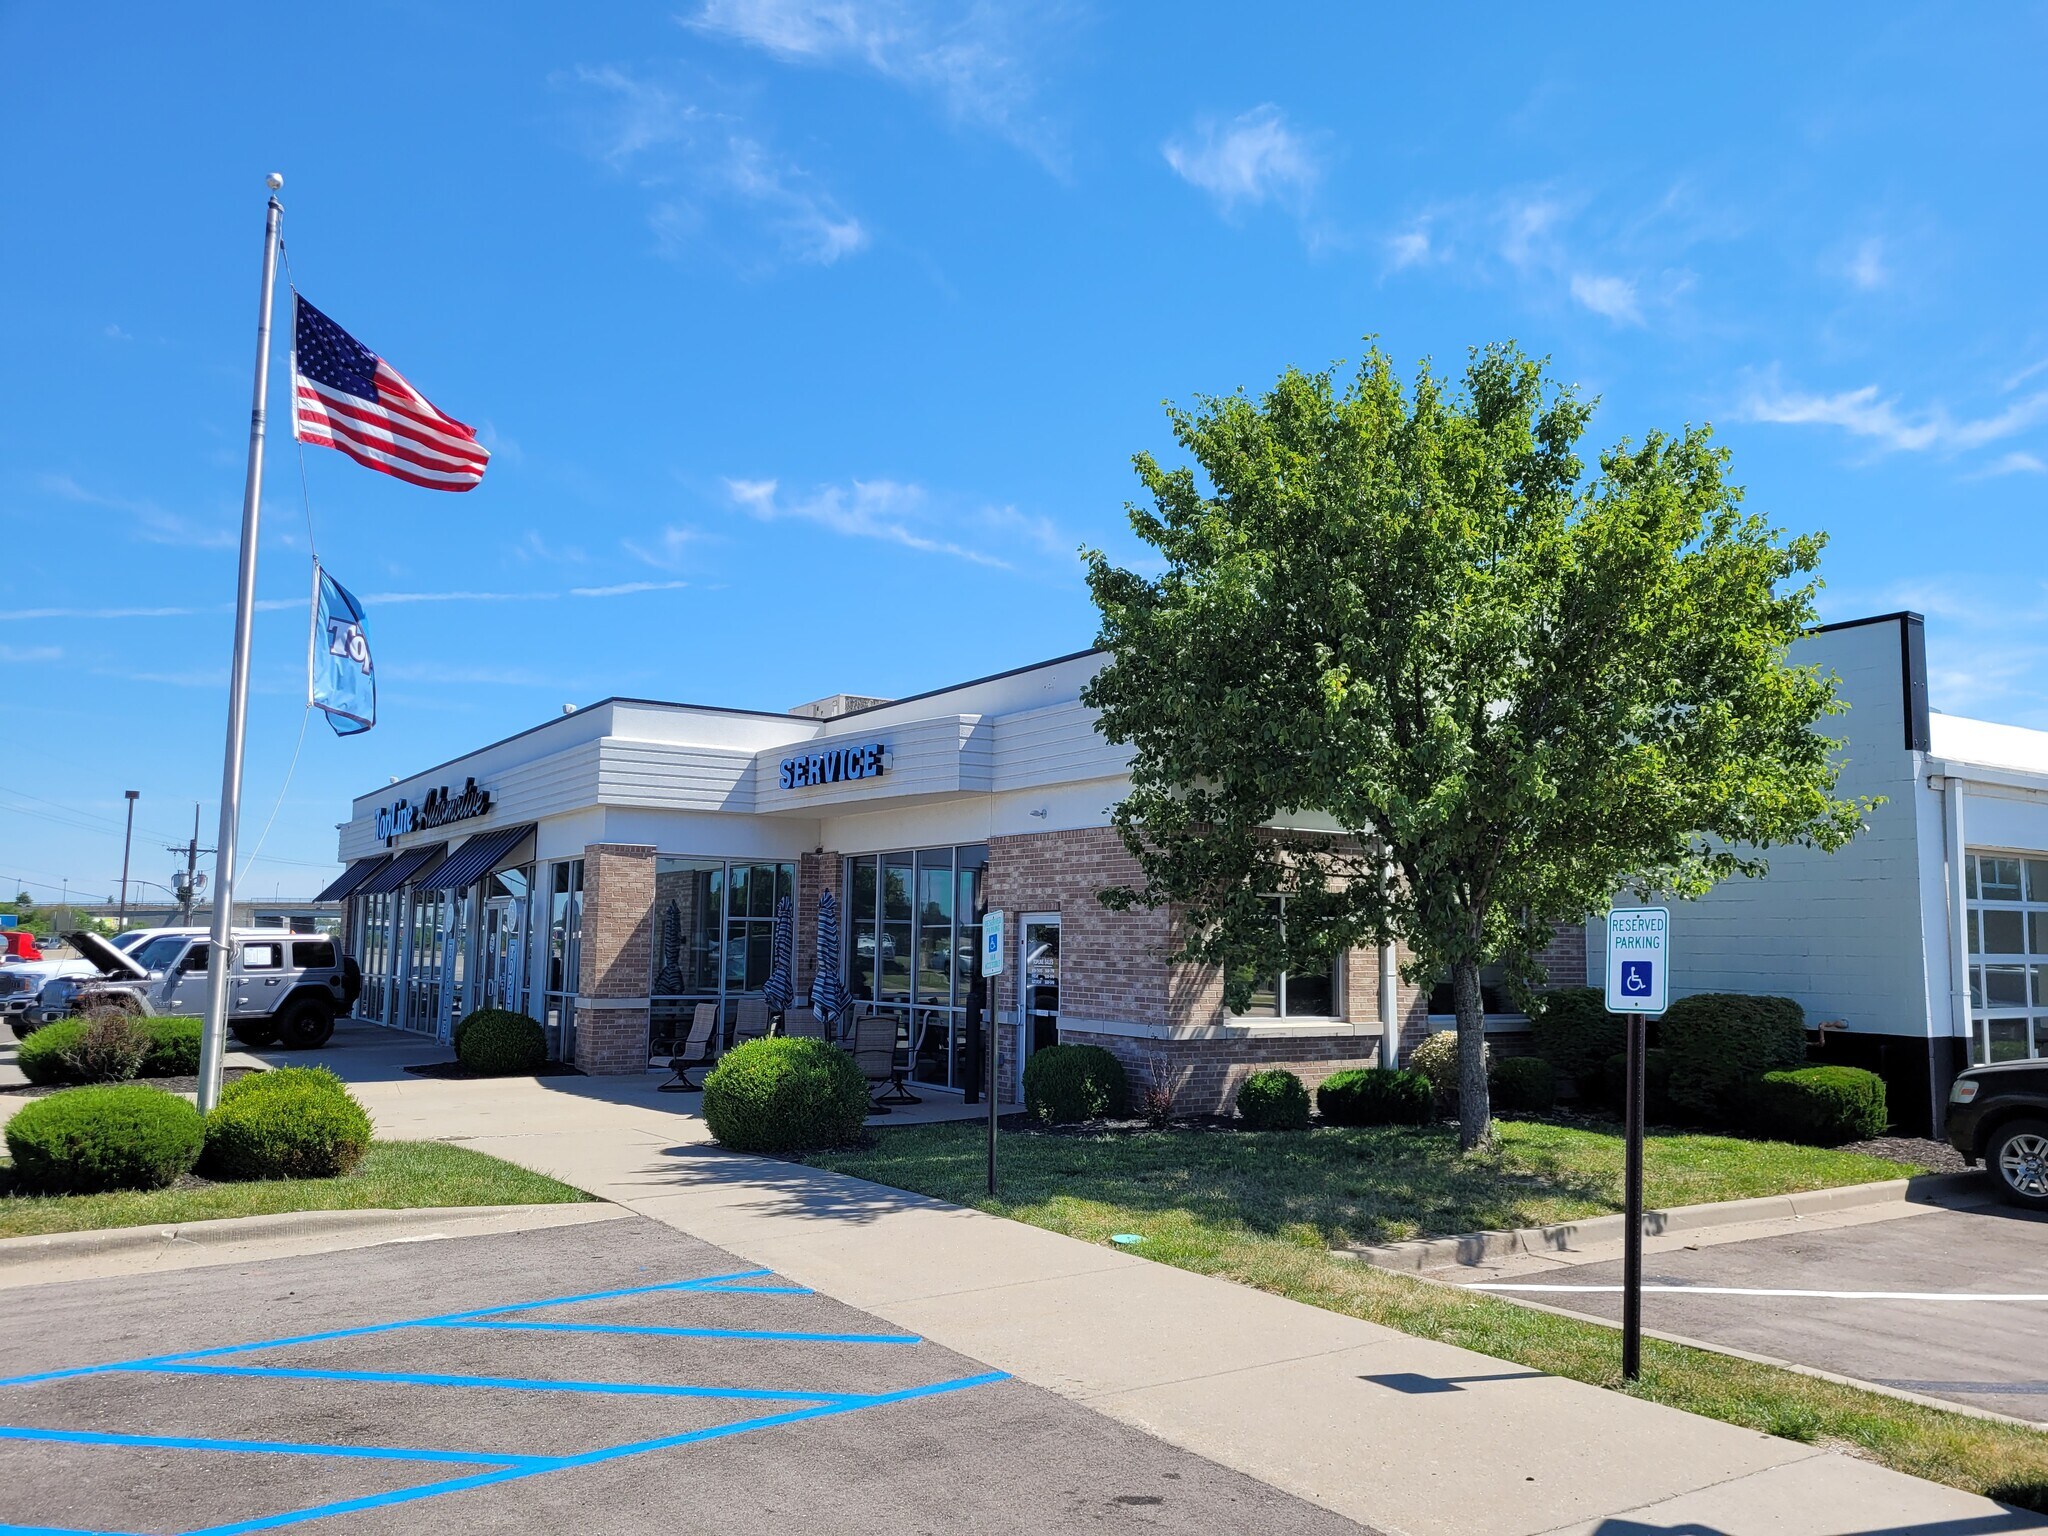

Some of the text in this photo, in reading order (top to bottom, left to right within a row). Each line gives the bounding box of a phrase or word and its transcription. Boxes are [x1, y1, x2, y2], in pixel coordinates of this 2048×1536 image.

[779, 744, 881, 789] SERVICE
[374, 777, 489, 848] TopLine Automotive
[1612, 918, 1664, 932] RESERVED
[1615, 936, 1660, 949] PARKING
